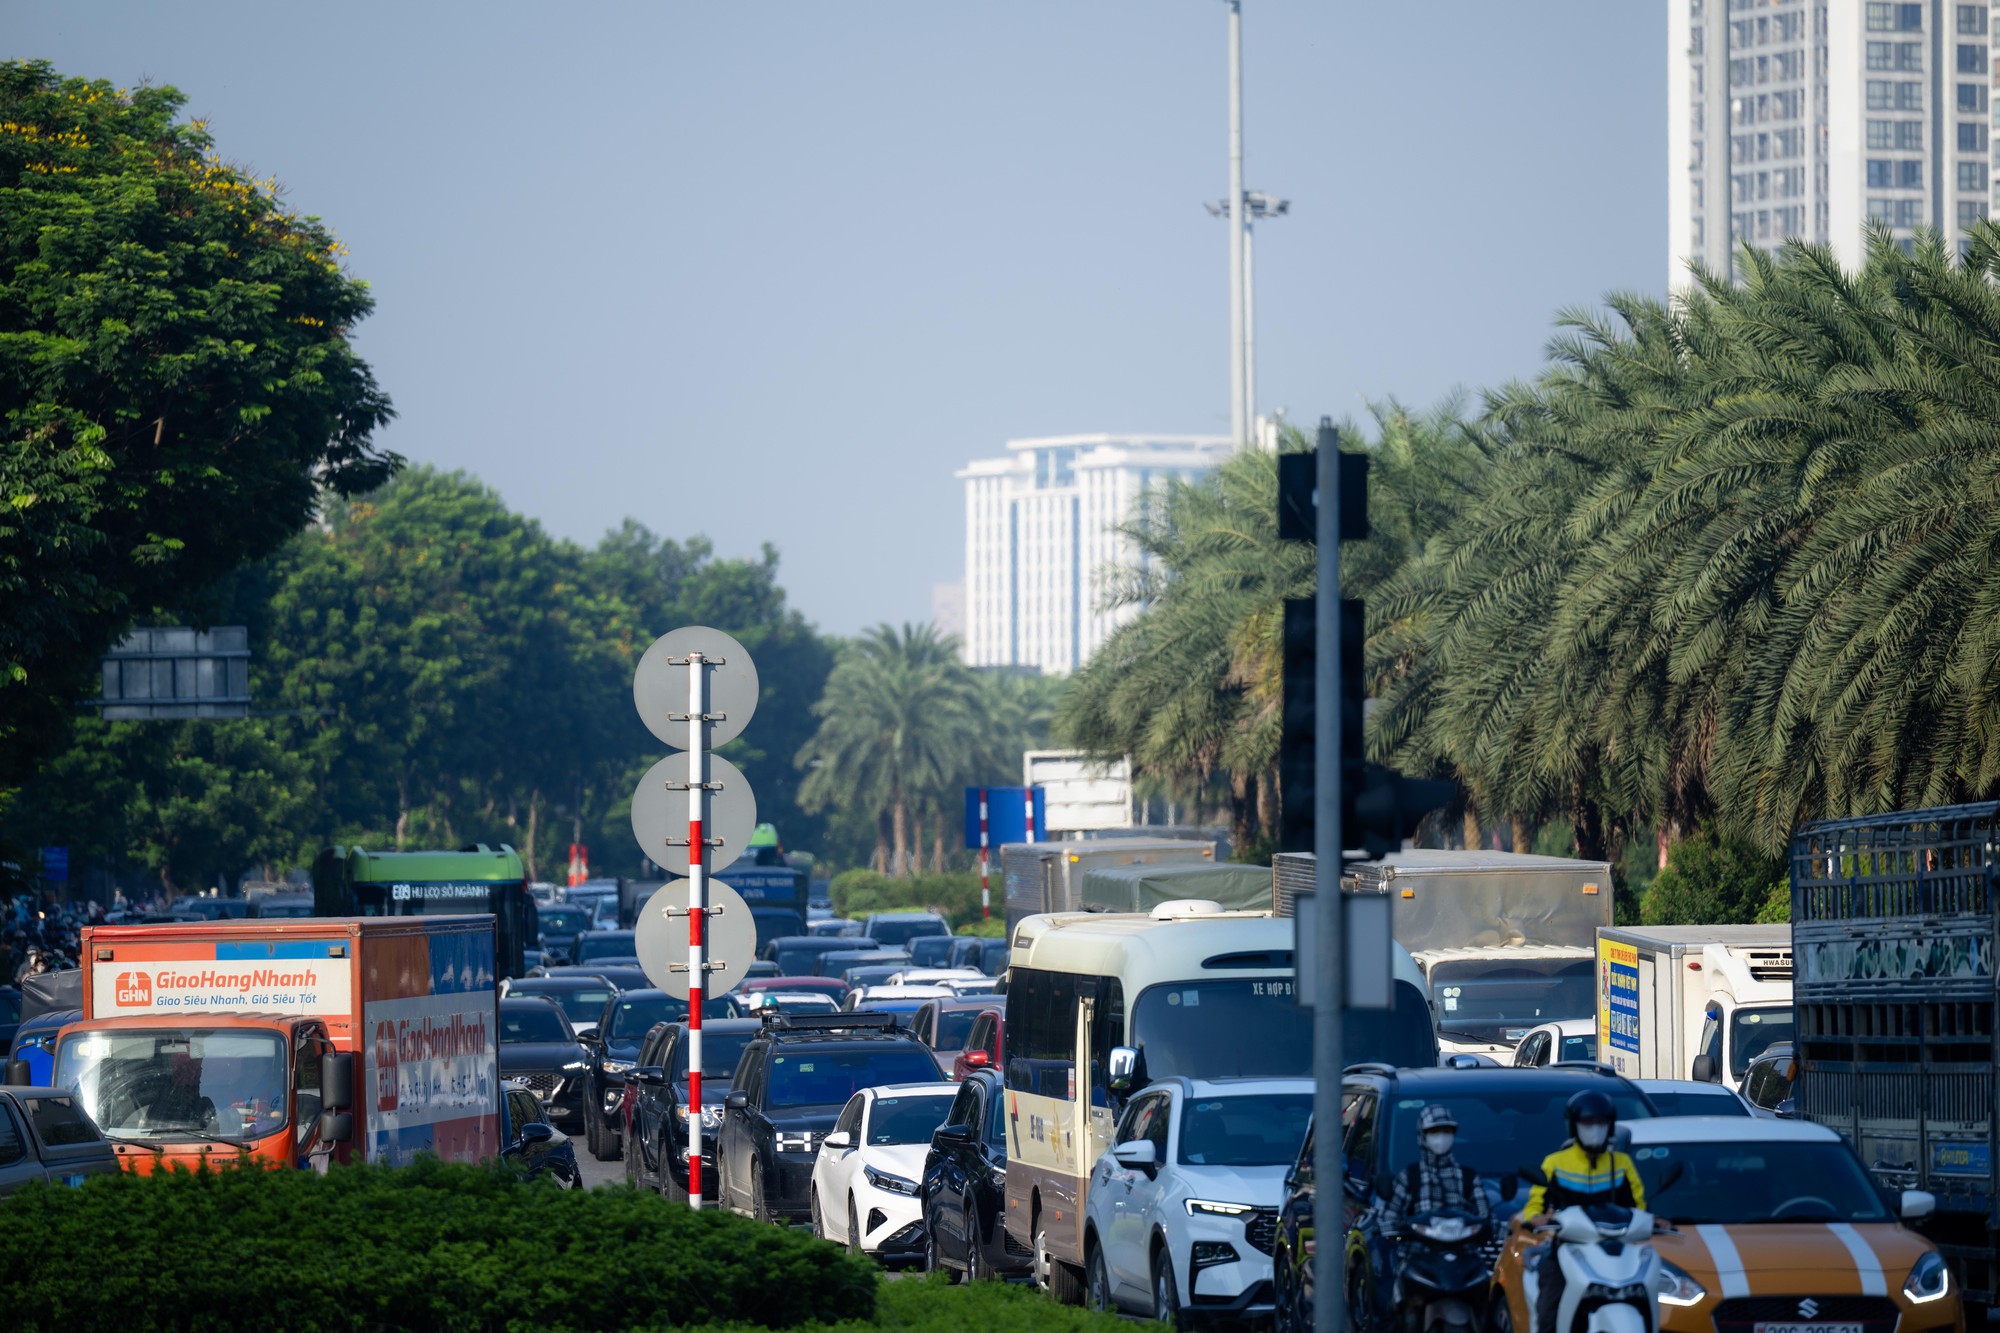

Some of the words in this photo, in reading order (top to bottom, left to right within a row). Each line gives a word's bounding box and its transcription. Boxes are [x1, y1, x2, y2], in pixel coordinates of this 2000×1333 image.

[157, 970, 317, 992] GiaoHangNhanh
[1252, 982, 1264, 995] XE
[1266, 981, 1283, 997] HỢP
[119, 990, 149, 1003] GHN
[156, 996, 181, 1006] Giao
[183, 995, 207, 1006] Siêu
[210, 995, 248, 1006] Nhanh,
[251, 995, 269, 1005] Giá
[272, 994, 295, 1004] Siêu
[299, 993, 317, 1004] Tốt
[400, 1012, 485, 1070] GiaoHangNhanh
[379, 1067, 397, 1099] GHN
